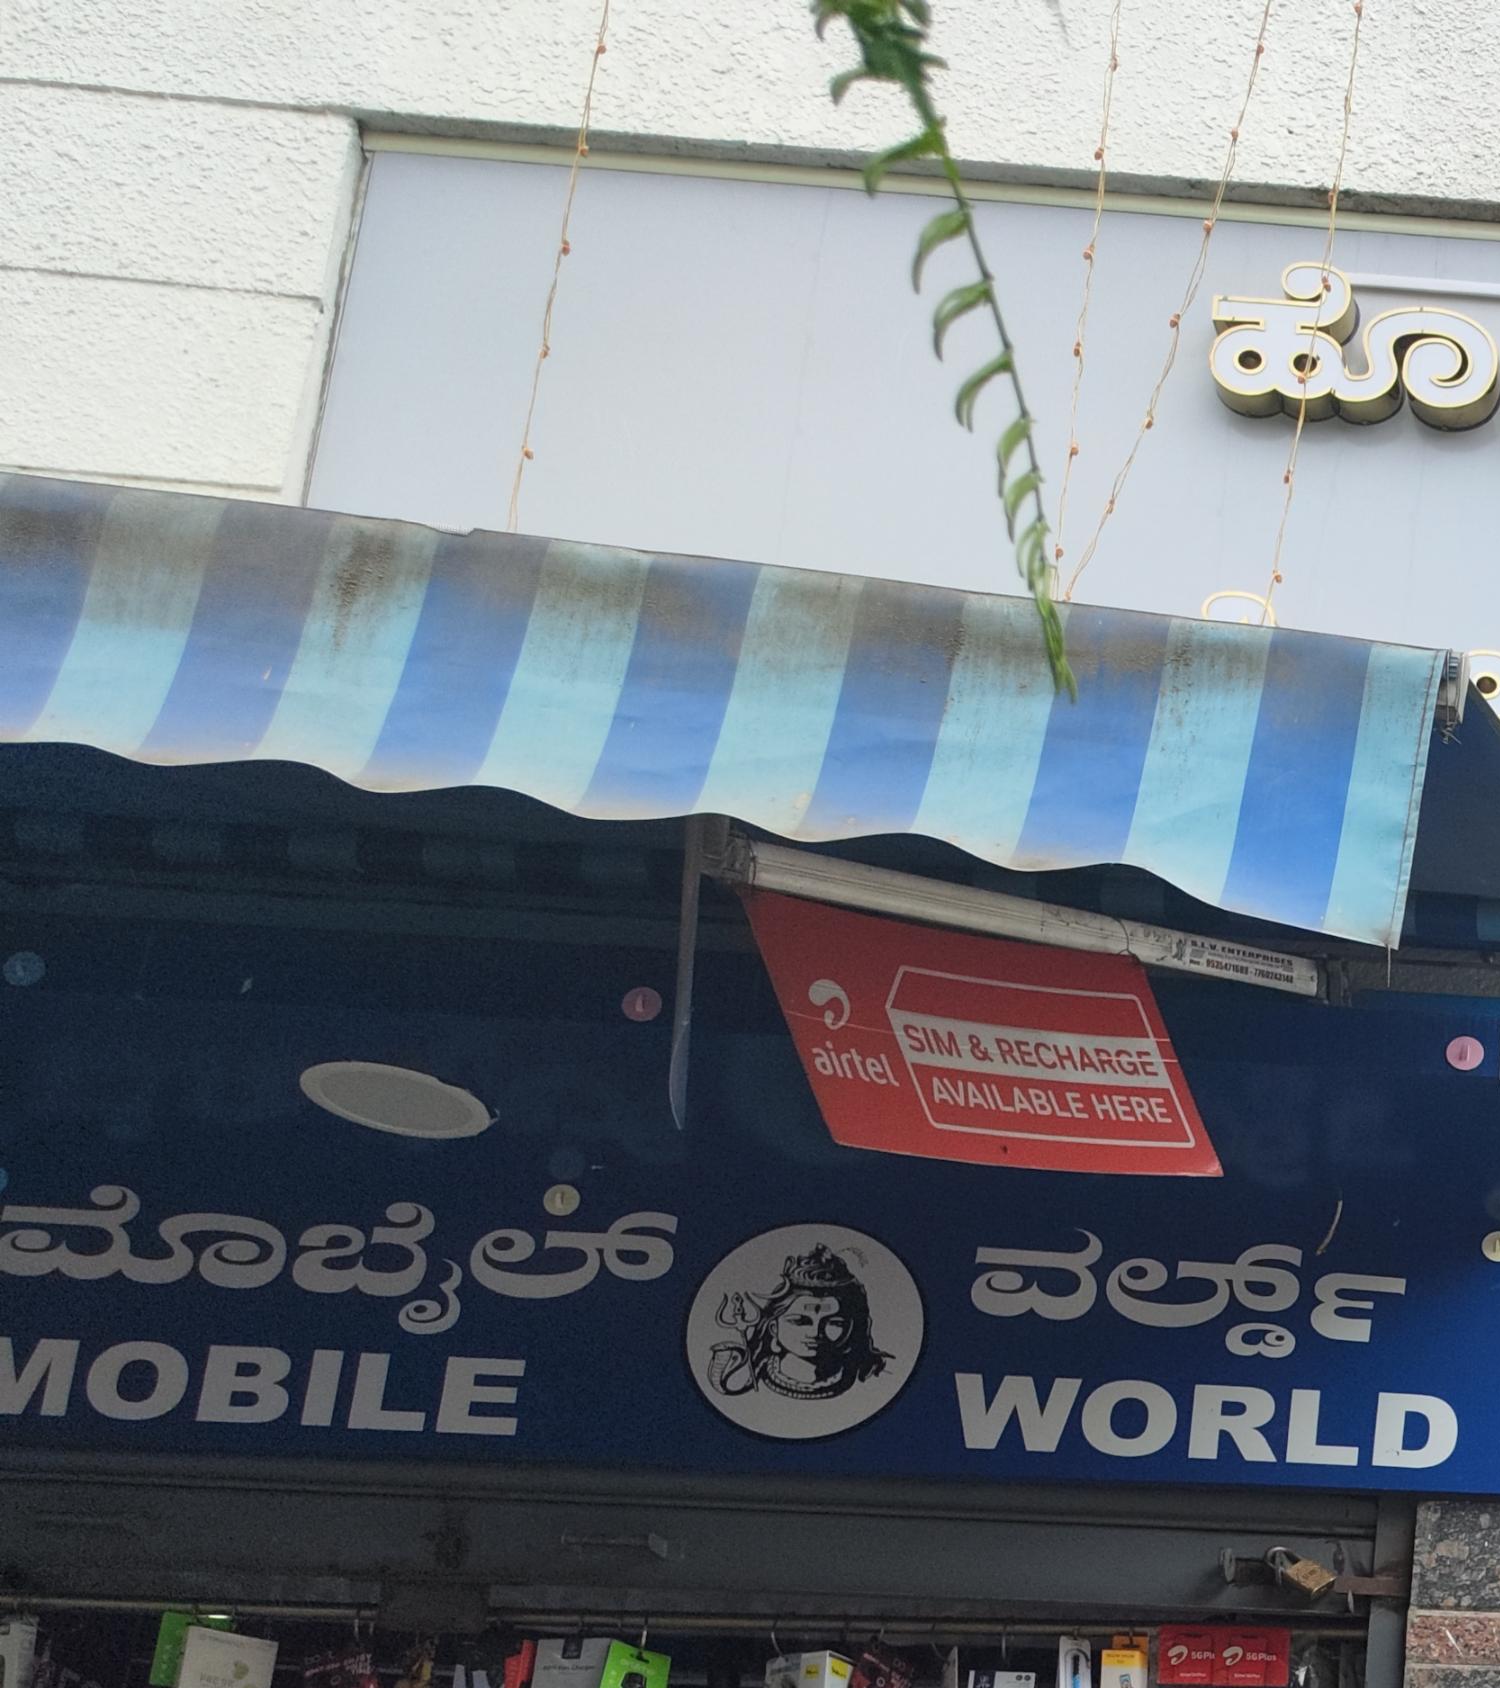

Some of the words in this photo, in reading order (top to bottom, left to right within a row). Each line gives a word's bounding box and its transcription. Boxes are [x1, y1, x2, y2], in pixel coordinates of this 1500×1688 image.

[812, 1041, 900, 1087] airtel
[903, 1024, 962, 1059] SIM
[968, 1033, 993, 1063] &
[998, 1037, 1160, 1077] RECHARGE
[932, 1076, 1090, 1120] AVAILABLE
[1091, 1094, 1173, 1124] HERE
[0, 1336, 526, 1436] MOBILE
[955, 1372, 1458, 1470] WORLD
